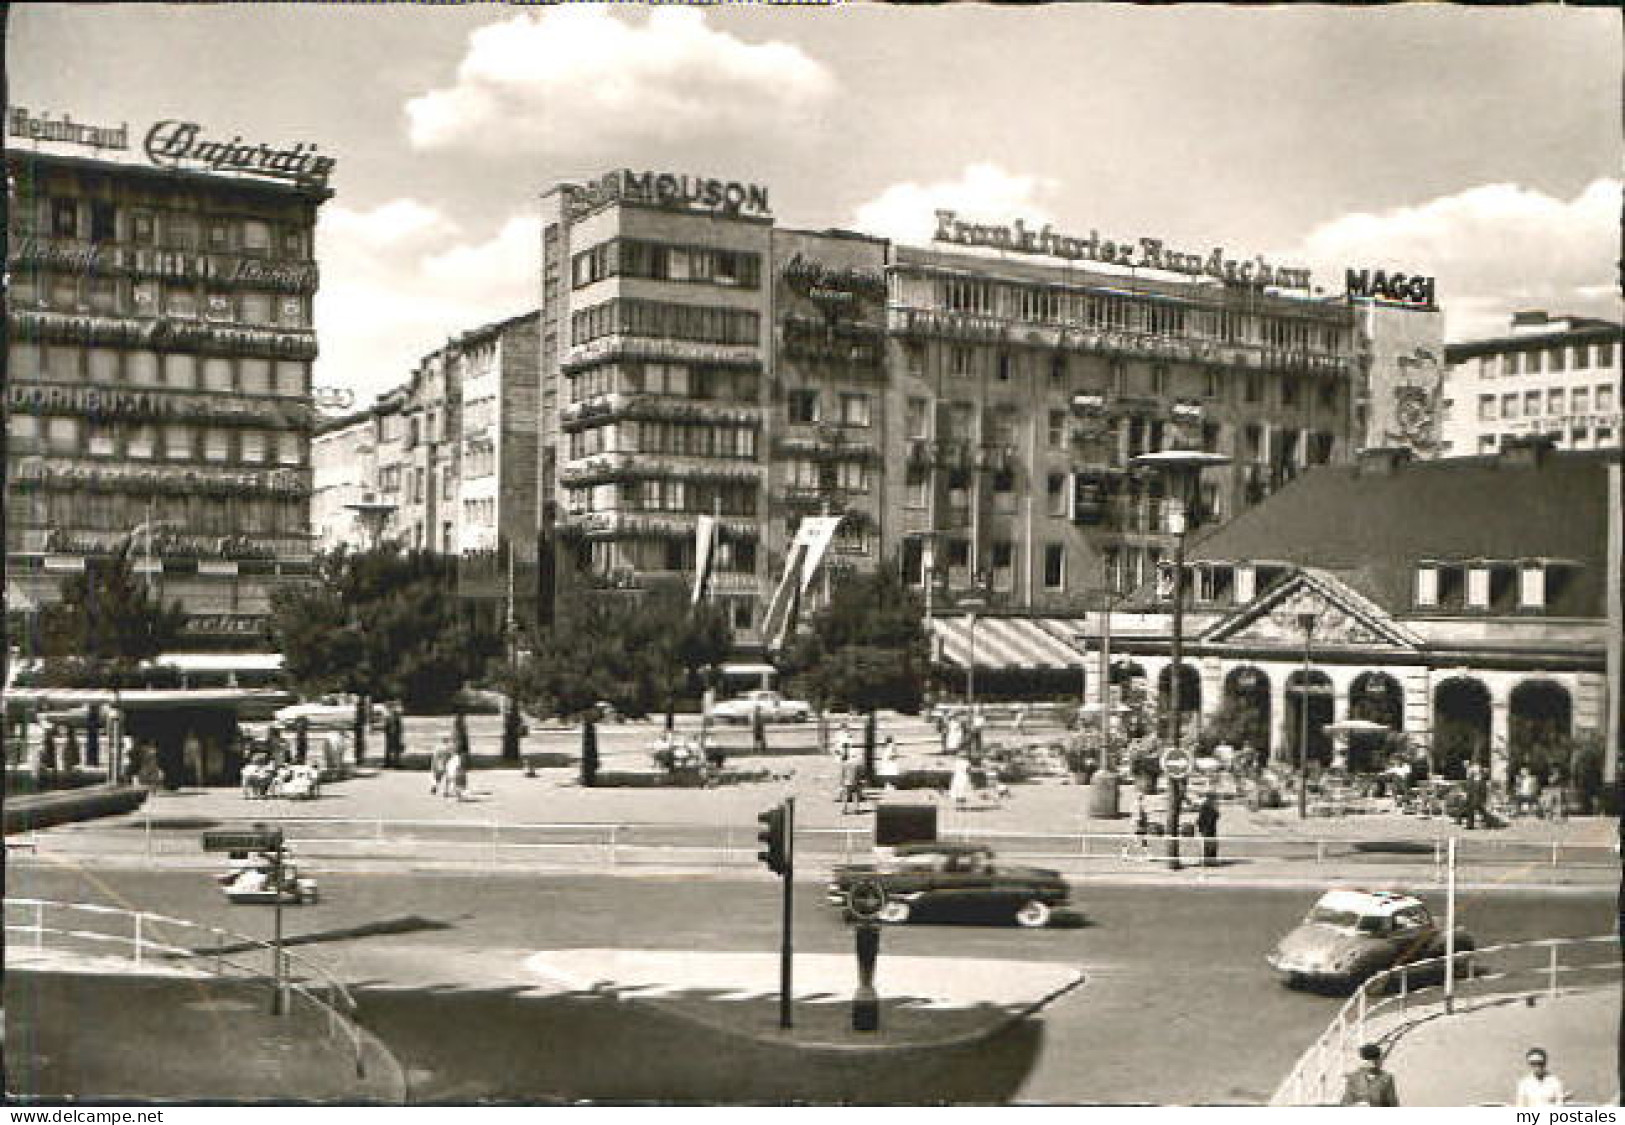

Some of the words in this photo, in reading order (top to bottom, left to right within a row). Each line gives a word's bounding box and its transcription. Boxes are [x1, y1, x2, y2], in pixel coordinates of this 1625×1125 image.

[623, 168, 772, 213] MOUSON
[934, 208, 1135, 267] Frankfurter
[1345, 268, 1435, 306] MAGGI
